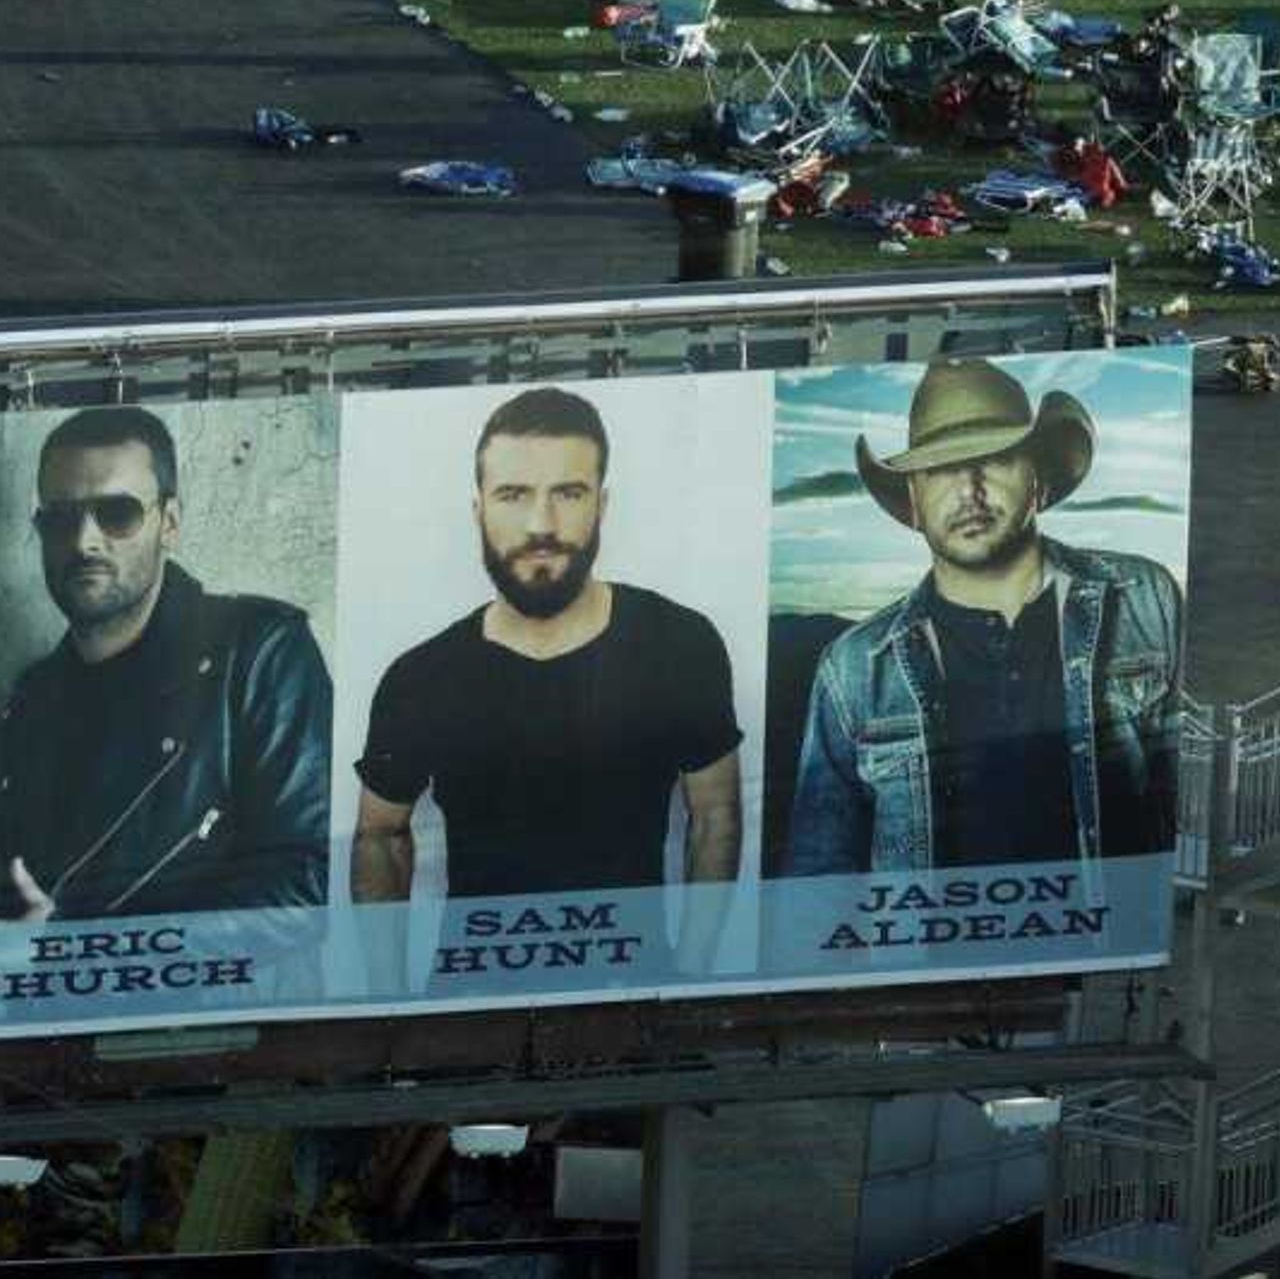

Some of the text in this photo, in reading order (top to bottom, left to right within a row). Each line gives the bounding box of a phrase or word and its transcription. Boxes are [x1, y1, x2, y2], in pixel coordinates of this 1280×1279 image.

[856, 874, 1078, 913] JASON
[465, 902, 618, 937] SAM
[819, 906, 1111, 950] ALDEAN
[29, 927, 185, 963] ERIC
[436, 936, 641, 974] HUNT
